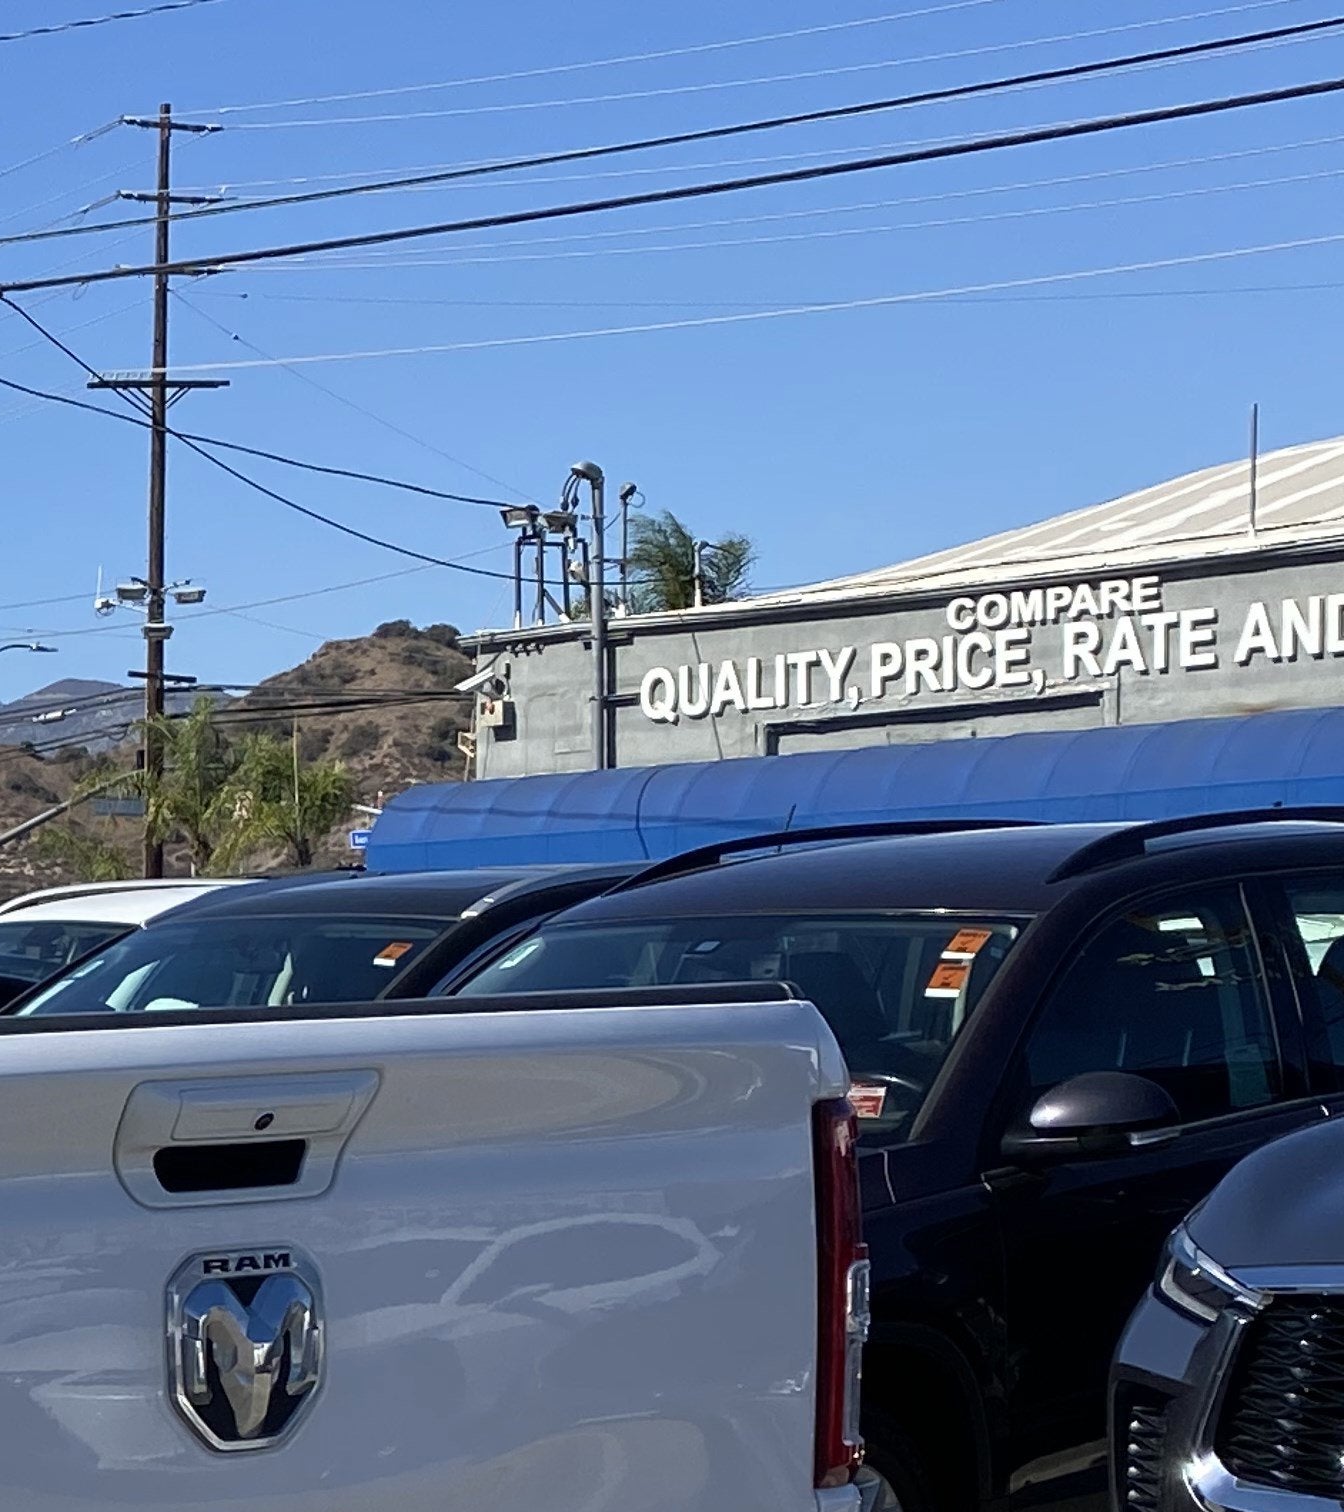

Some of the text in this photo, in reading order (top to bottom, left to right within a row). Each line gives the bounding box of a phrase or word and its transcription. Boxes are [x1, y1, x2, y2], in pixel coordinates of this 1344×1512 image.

[947, 576, 1162, 631] COMPARE
[640, 646, 858, 724] QUALITY,
[871, 628, 1046, 695] PRICE,
[1063, 607, 1217, 679] RATE
[203, 1252, 292, 1275] RAM
